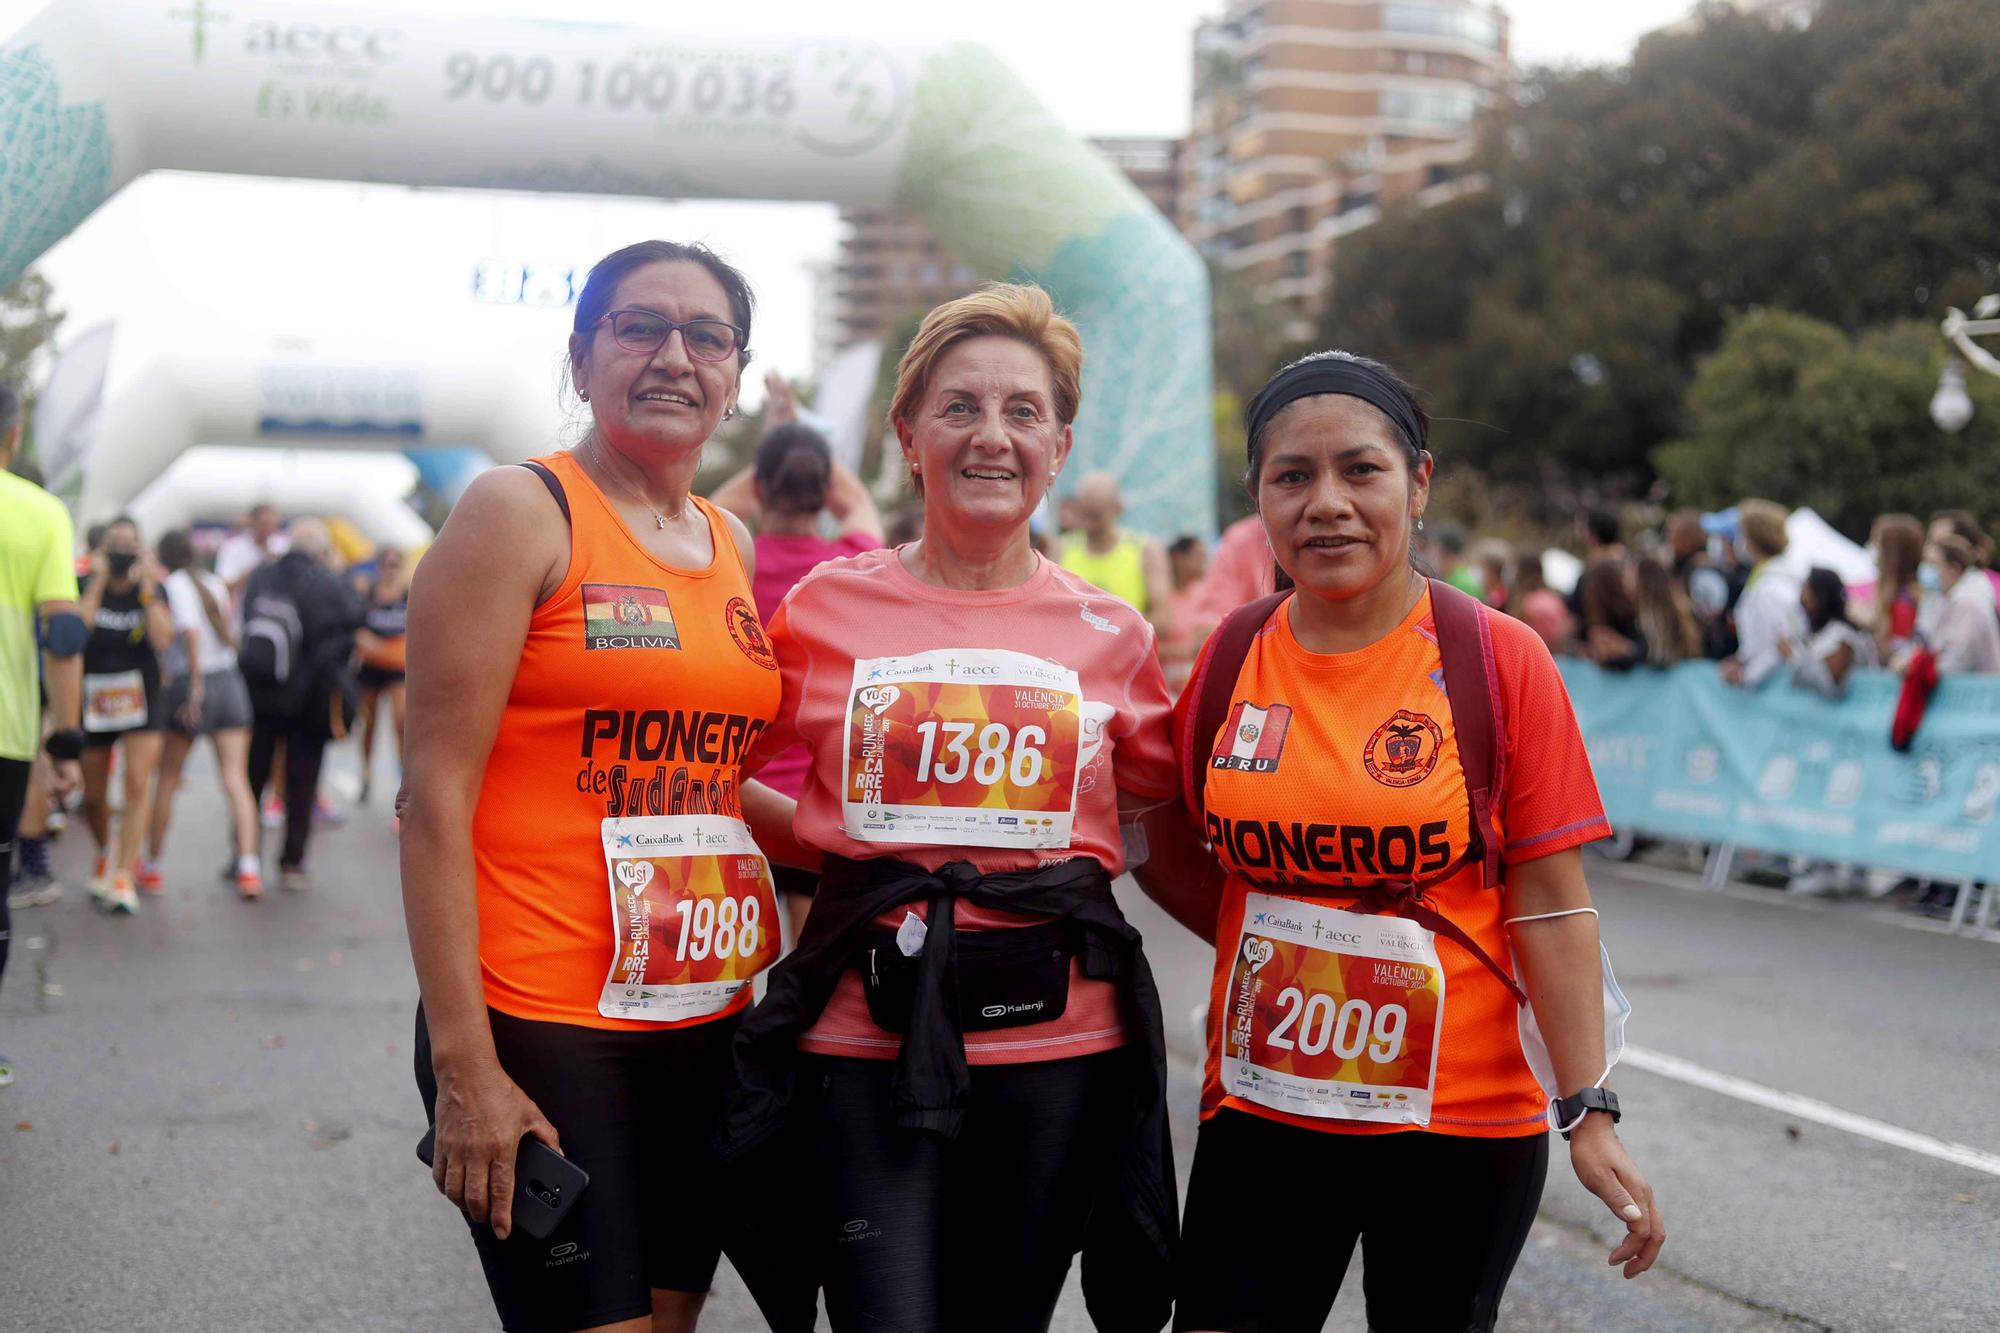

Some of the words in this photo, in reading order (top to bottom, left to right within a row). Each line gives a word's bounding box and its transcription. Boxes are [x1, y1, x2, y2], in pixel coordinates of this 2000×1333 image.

[445, 52, 555, 104] 900
[578, 60, 676, 112] 100
[693, 67, 796, 116] 036
[595, 636, 678, 649] BOLIVIA
[886, 663, 934, 676] CaixaBank
[962, 665, 1000, 676] aecc
[866, 689, 880, 701] YO
[580, 709, 773, 765] PIONERO
[863, 732, 877, 758] RUN
[916, 721, 1046, 787] 1386
[865, 758, 883, 773] CA
[1213, 757, 1269, 772] PERU
[576, 760, 607, 794] de
[856, 774, 884, 789] RRE
[636, 834, 684, 845] CaixaBank
[705, 834, 728, 844] aecc
[1206, 810, 1451, 875] PIONEROS
[621, 865, 635, 878] YO
[631, 914, 642, 940] RUN
[676, 895, 760, 961] 1988
[1266, 914, 1303, 932] CaixaBank
[1325, 929, 1362, 944] aecc
[632, 940, 648, 955] CA
[1248, 941, 1259, 955] YO
[622, 956, 649, 971] RRE
[1374, 963, 1425, 981] VALÈNCIA
[1372, 976, 1379, 984] 31
[1380, 977, 1409, 987] OCTUBRE
[1007, 1000, 1044, 1014] Kalenji
[1237, 991, 1250, 1016] RUN
[1237, 1017, 1252, 1033] CA
[1266, 987, 1407, 1064] 2009
[1231, 1030, 1251, 1047] RRE
[546, 1250, 590, 1268] Kalenji
